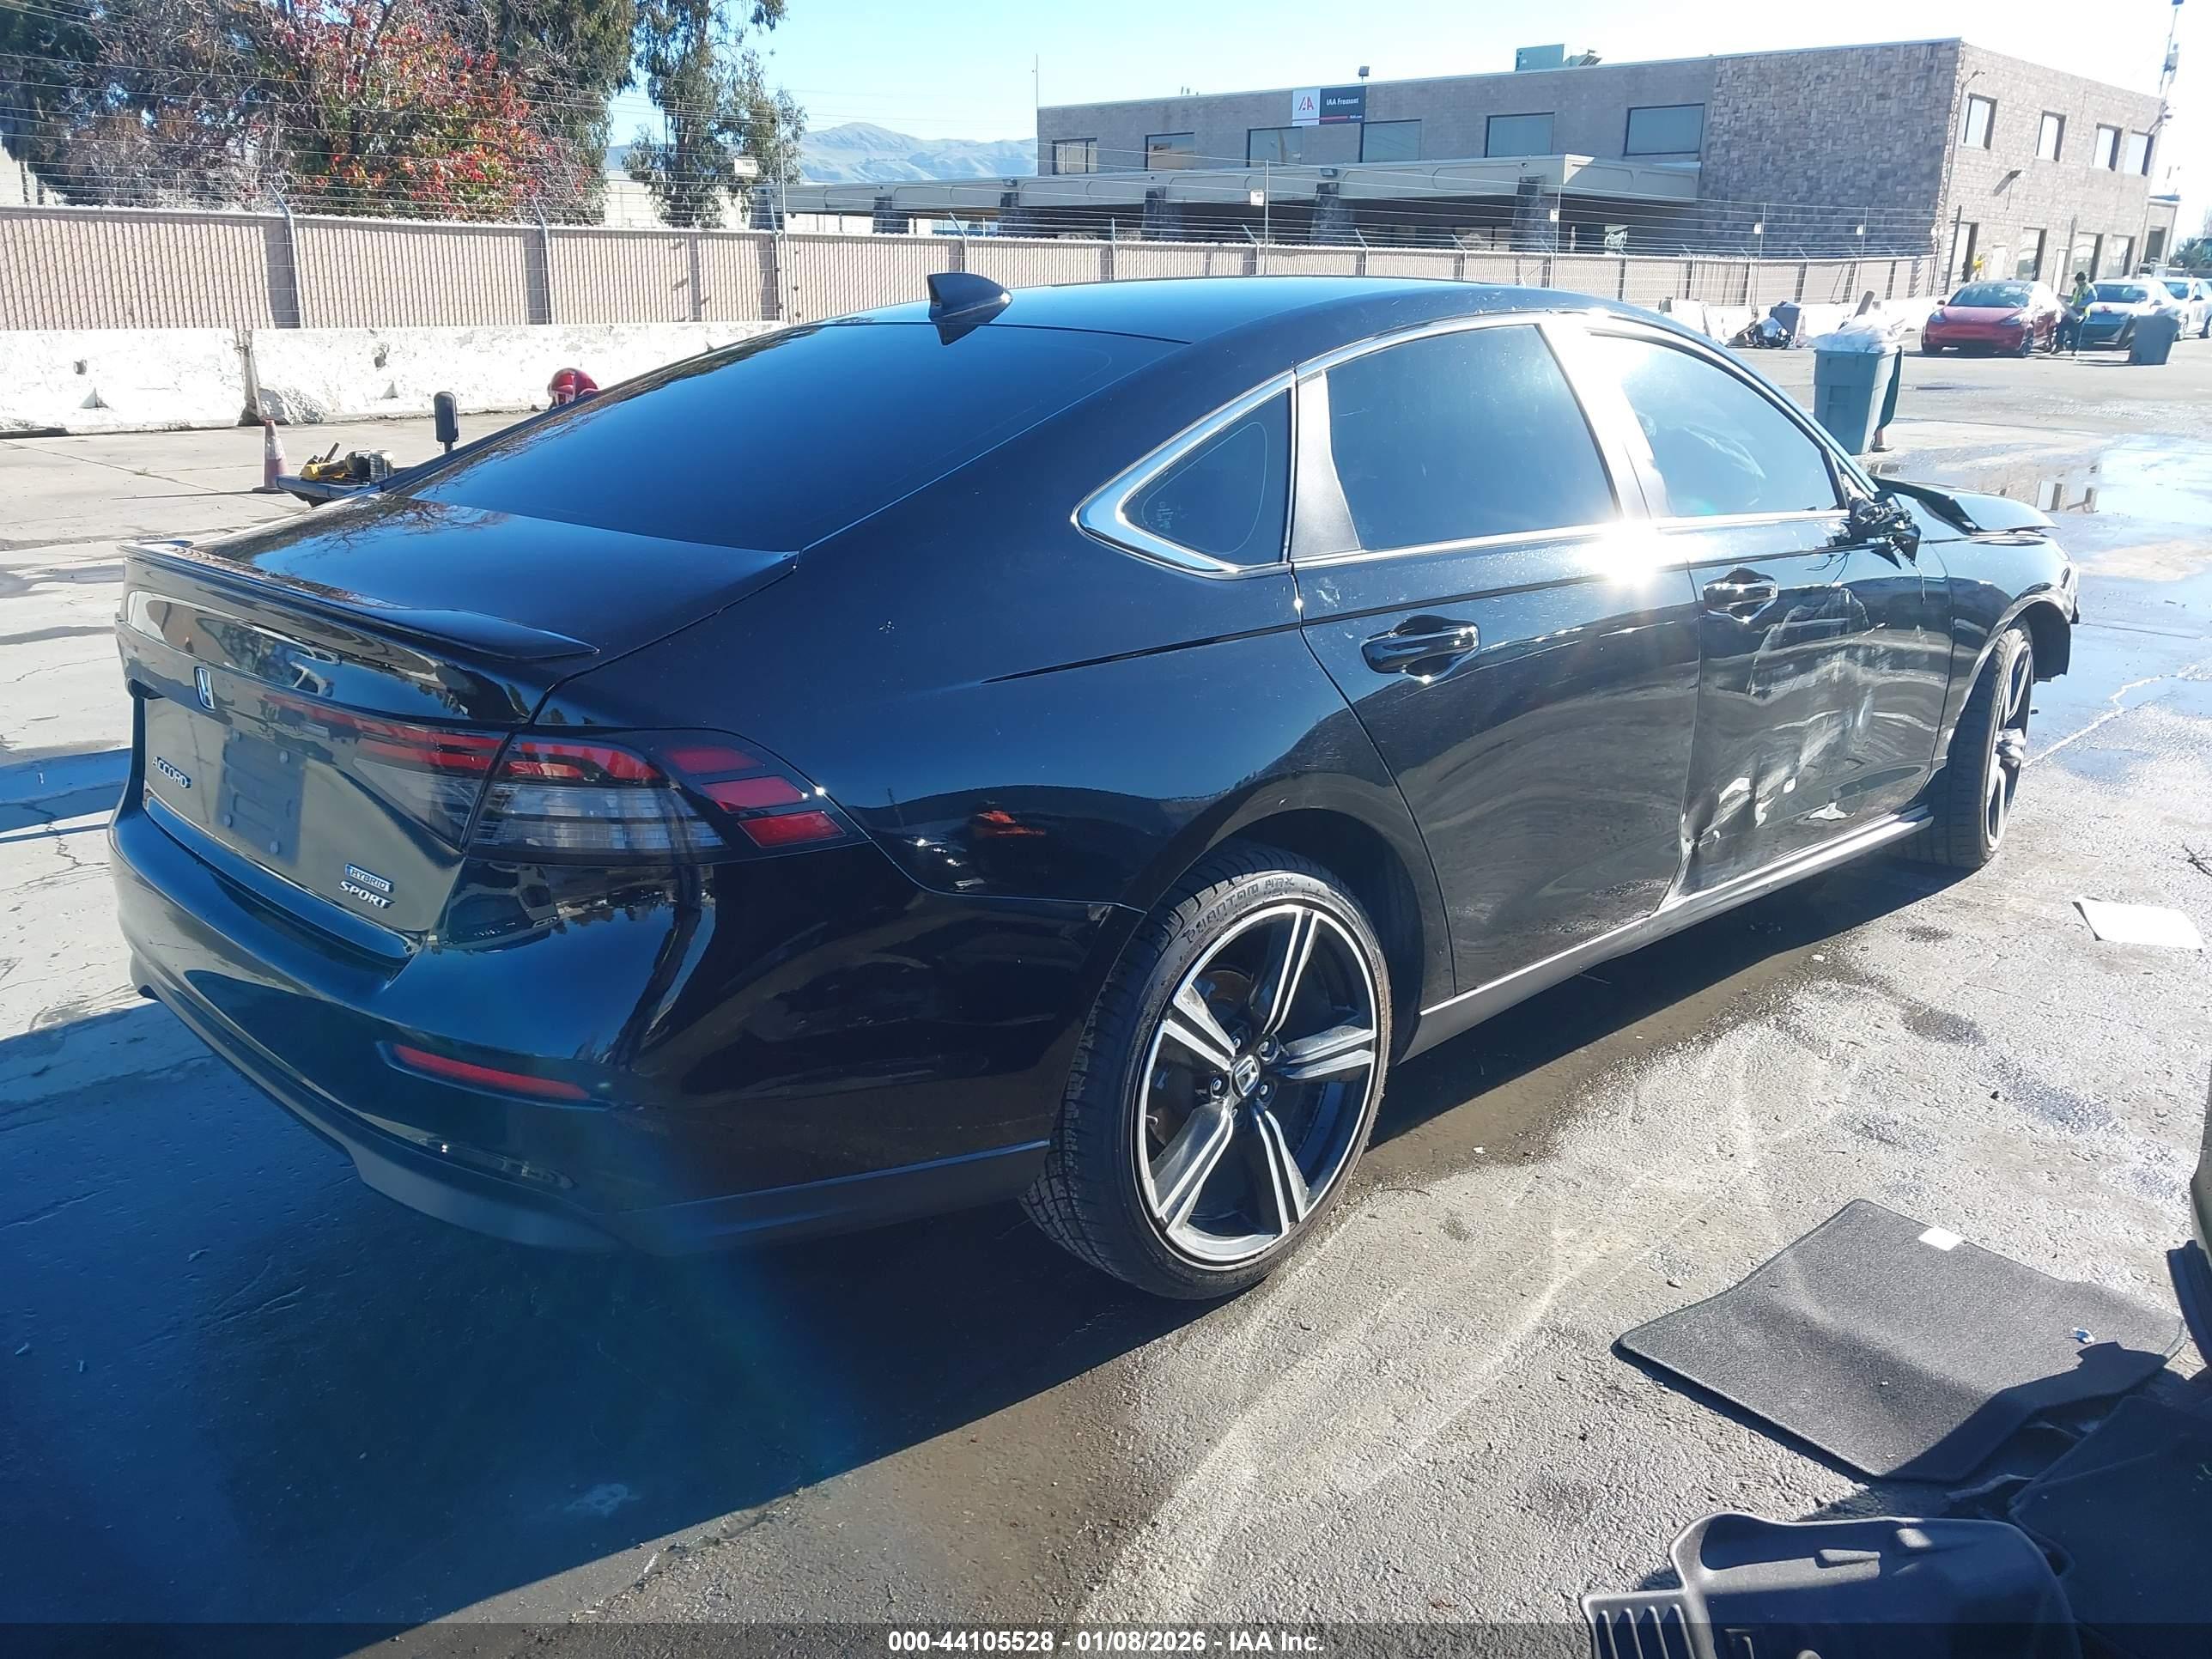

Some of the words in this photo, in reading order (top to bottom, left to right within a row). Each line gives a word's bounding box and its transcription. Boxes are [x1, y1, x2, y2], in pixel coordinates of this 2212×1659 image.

[152, 756, 188, 788] ACCORD
[349, 867, 389, 890] HYBRID
[338, 881, 392, 908] SPORT
